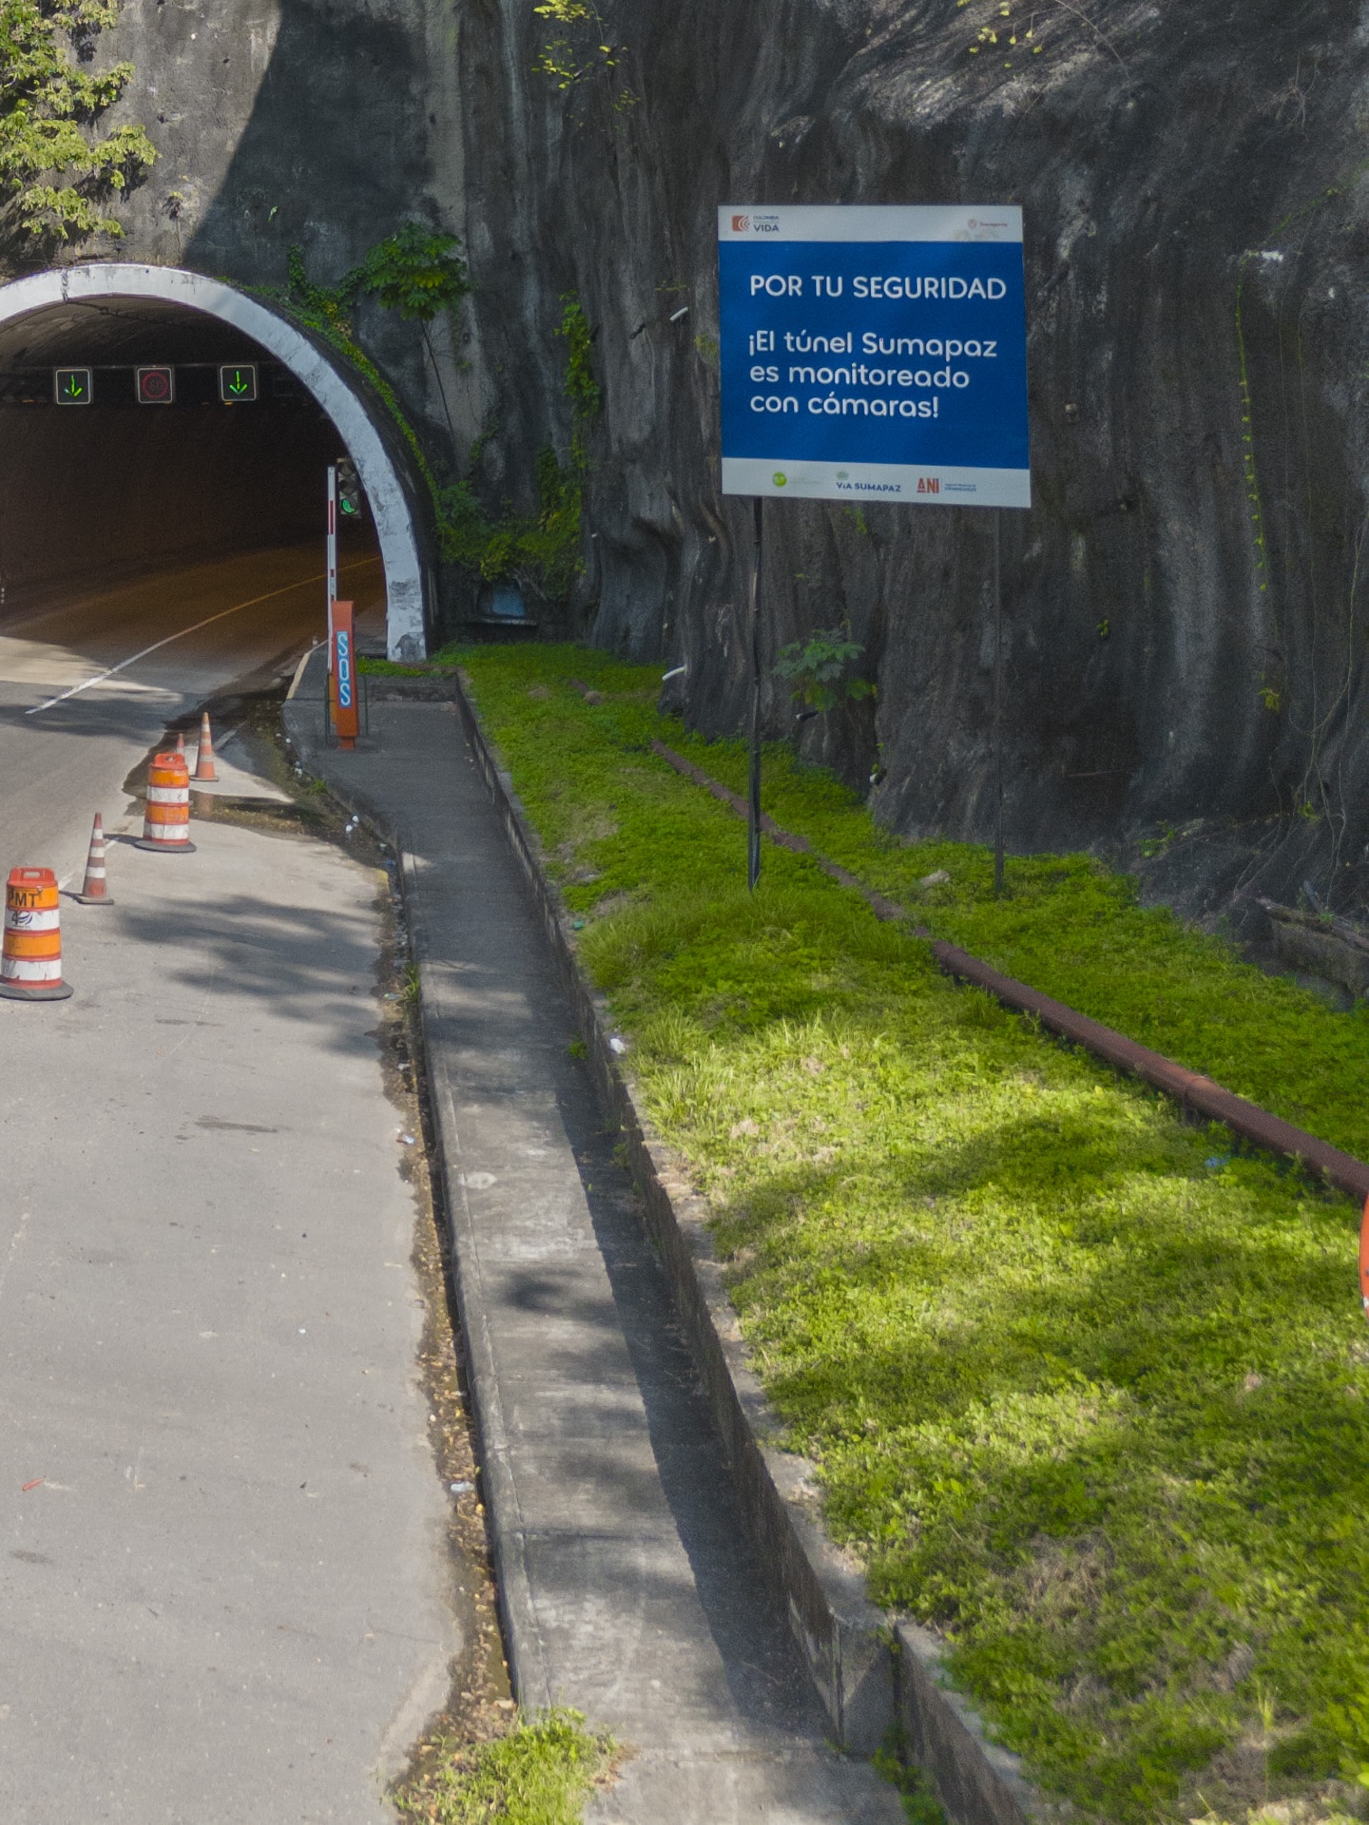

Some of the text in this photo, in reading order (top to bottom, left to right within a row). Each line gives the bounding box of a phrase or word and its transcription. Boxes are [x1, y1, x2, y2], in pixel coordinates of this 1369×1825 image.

[753, 224, 779, 232] VIDA
[750, 275, 1006, 299] POR TU SEGURIDAD
[749, 329, 997, 362] ¡El túnel Sumapaz
[749, 361, 970, 388] es monitoreado
[750, 391, 939, 418] con cámaras!
[854, 482, 902, 492] SUMAPAZ
[337, 634, 351, 706] SOS
[8, 887, 37, 907] PMT
